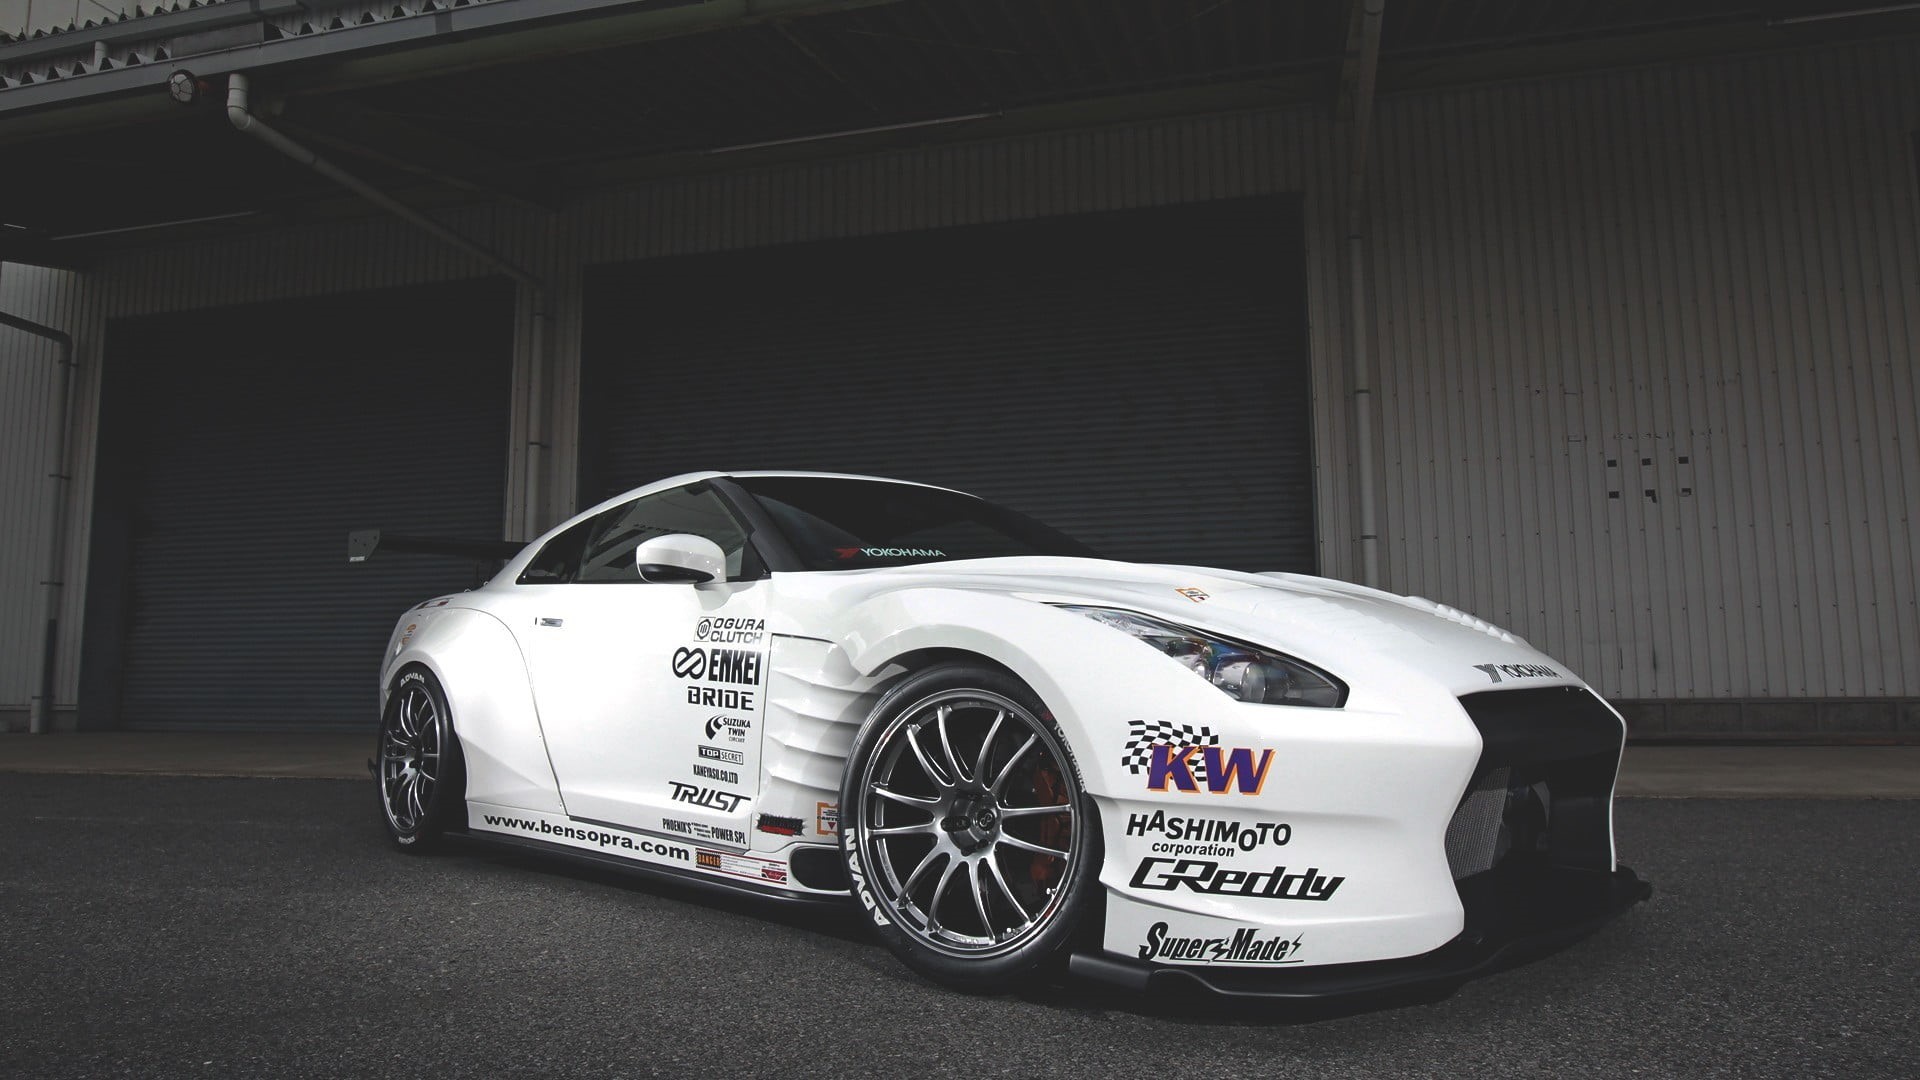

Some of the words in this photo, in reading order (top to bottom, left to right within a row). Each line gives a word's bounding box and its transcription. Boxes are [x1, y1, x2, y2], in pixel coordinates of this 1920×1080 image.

[861, 548, 946, 557] YOKOHAMA
[713, 618, 765, 631] OGURA
[710, 631, 762, 643] CLUTCH
[708, 648, 761, 686] ENKEI
[400, 672, 425, 687] ADVAN
[687, 685, 754, 711] BRIDE
[722, 717, 751, 728] SUZUKA
[728, 727, 746, 737] TWIN
[701, 748, 719, 757] TOP
[721, 751, 742, 763] SECRET
[1146, 744, 1276, 796] KW
[668, 781, 752, 813] TRUST
[483, 814, 690, 861] www.bensopra.com
[711, 826, 734, 842] POWER
[734, 830, 746, 844] SPL
[1126, 810, 1292, 851] HASHIMOTO
[1151, 842, 1235, 857] corporation
[698, 854, 721, 866] DANGER
[844, 828, 892, 926] ADVAN
[1129, 856, 1346, 901] GReddy
[1226, 928, 1291, 961] Made
